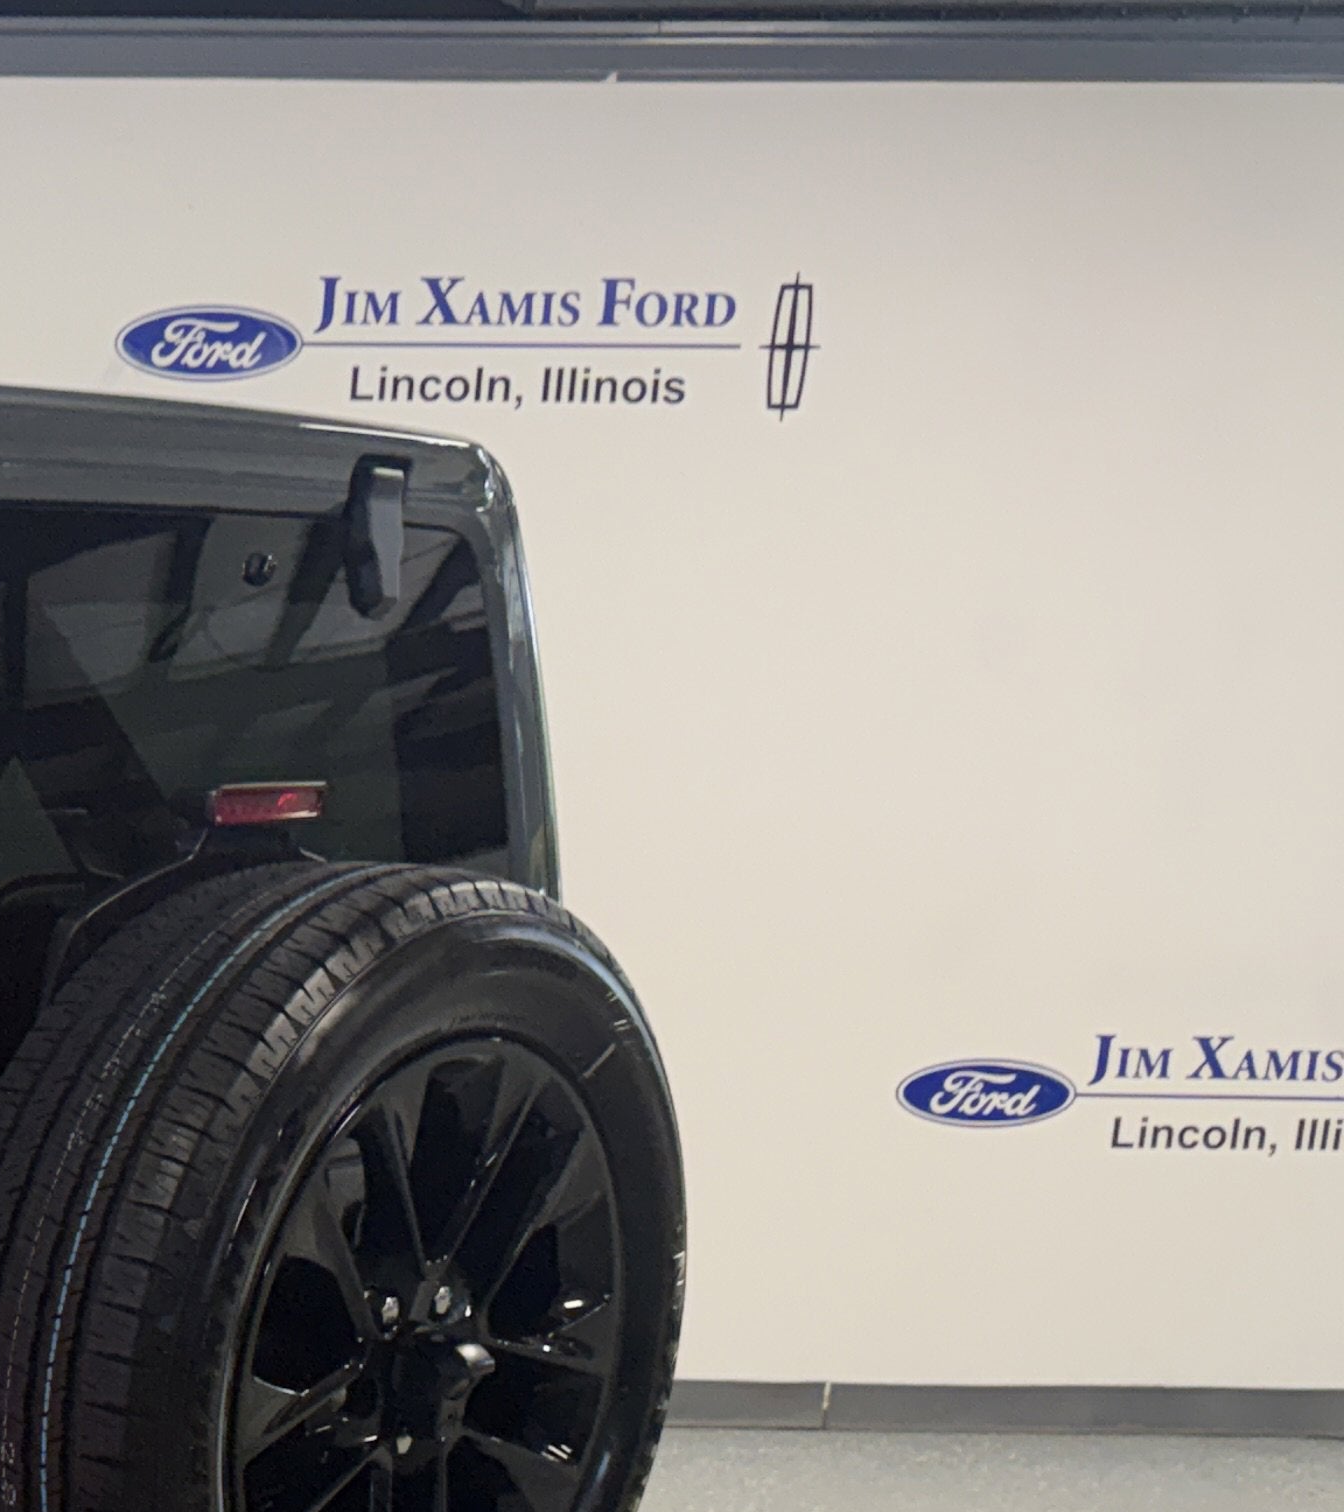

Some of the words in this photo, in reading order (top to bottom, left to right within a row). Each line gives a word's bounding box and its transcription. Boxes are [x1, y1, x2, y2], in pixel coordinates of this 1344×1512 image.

[313, 275, 402, 334] JIM
[415, 276, 582, 329] XAMIS
[597, 277, 737, 328] FORD
[150, 317, 267, 369] Ford
[348, 366, 524, 411] Lincoln,
[540, 366, 687, 404] Illinois
[1087, 1033, 1174, 1086] JIM
[1186, 1034, 1344, 1083] XAMIS
[928, 1069, 1043, 1118] Ford
[1110, 1117, 1278, 1157] Lincoln,
